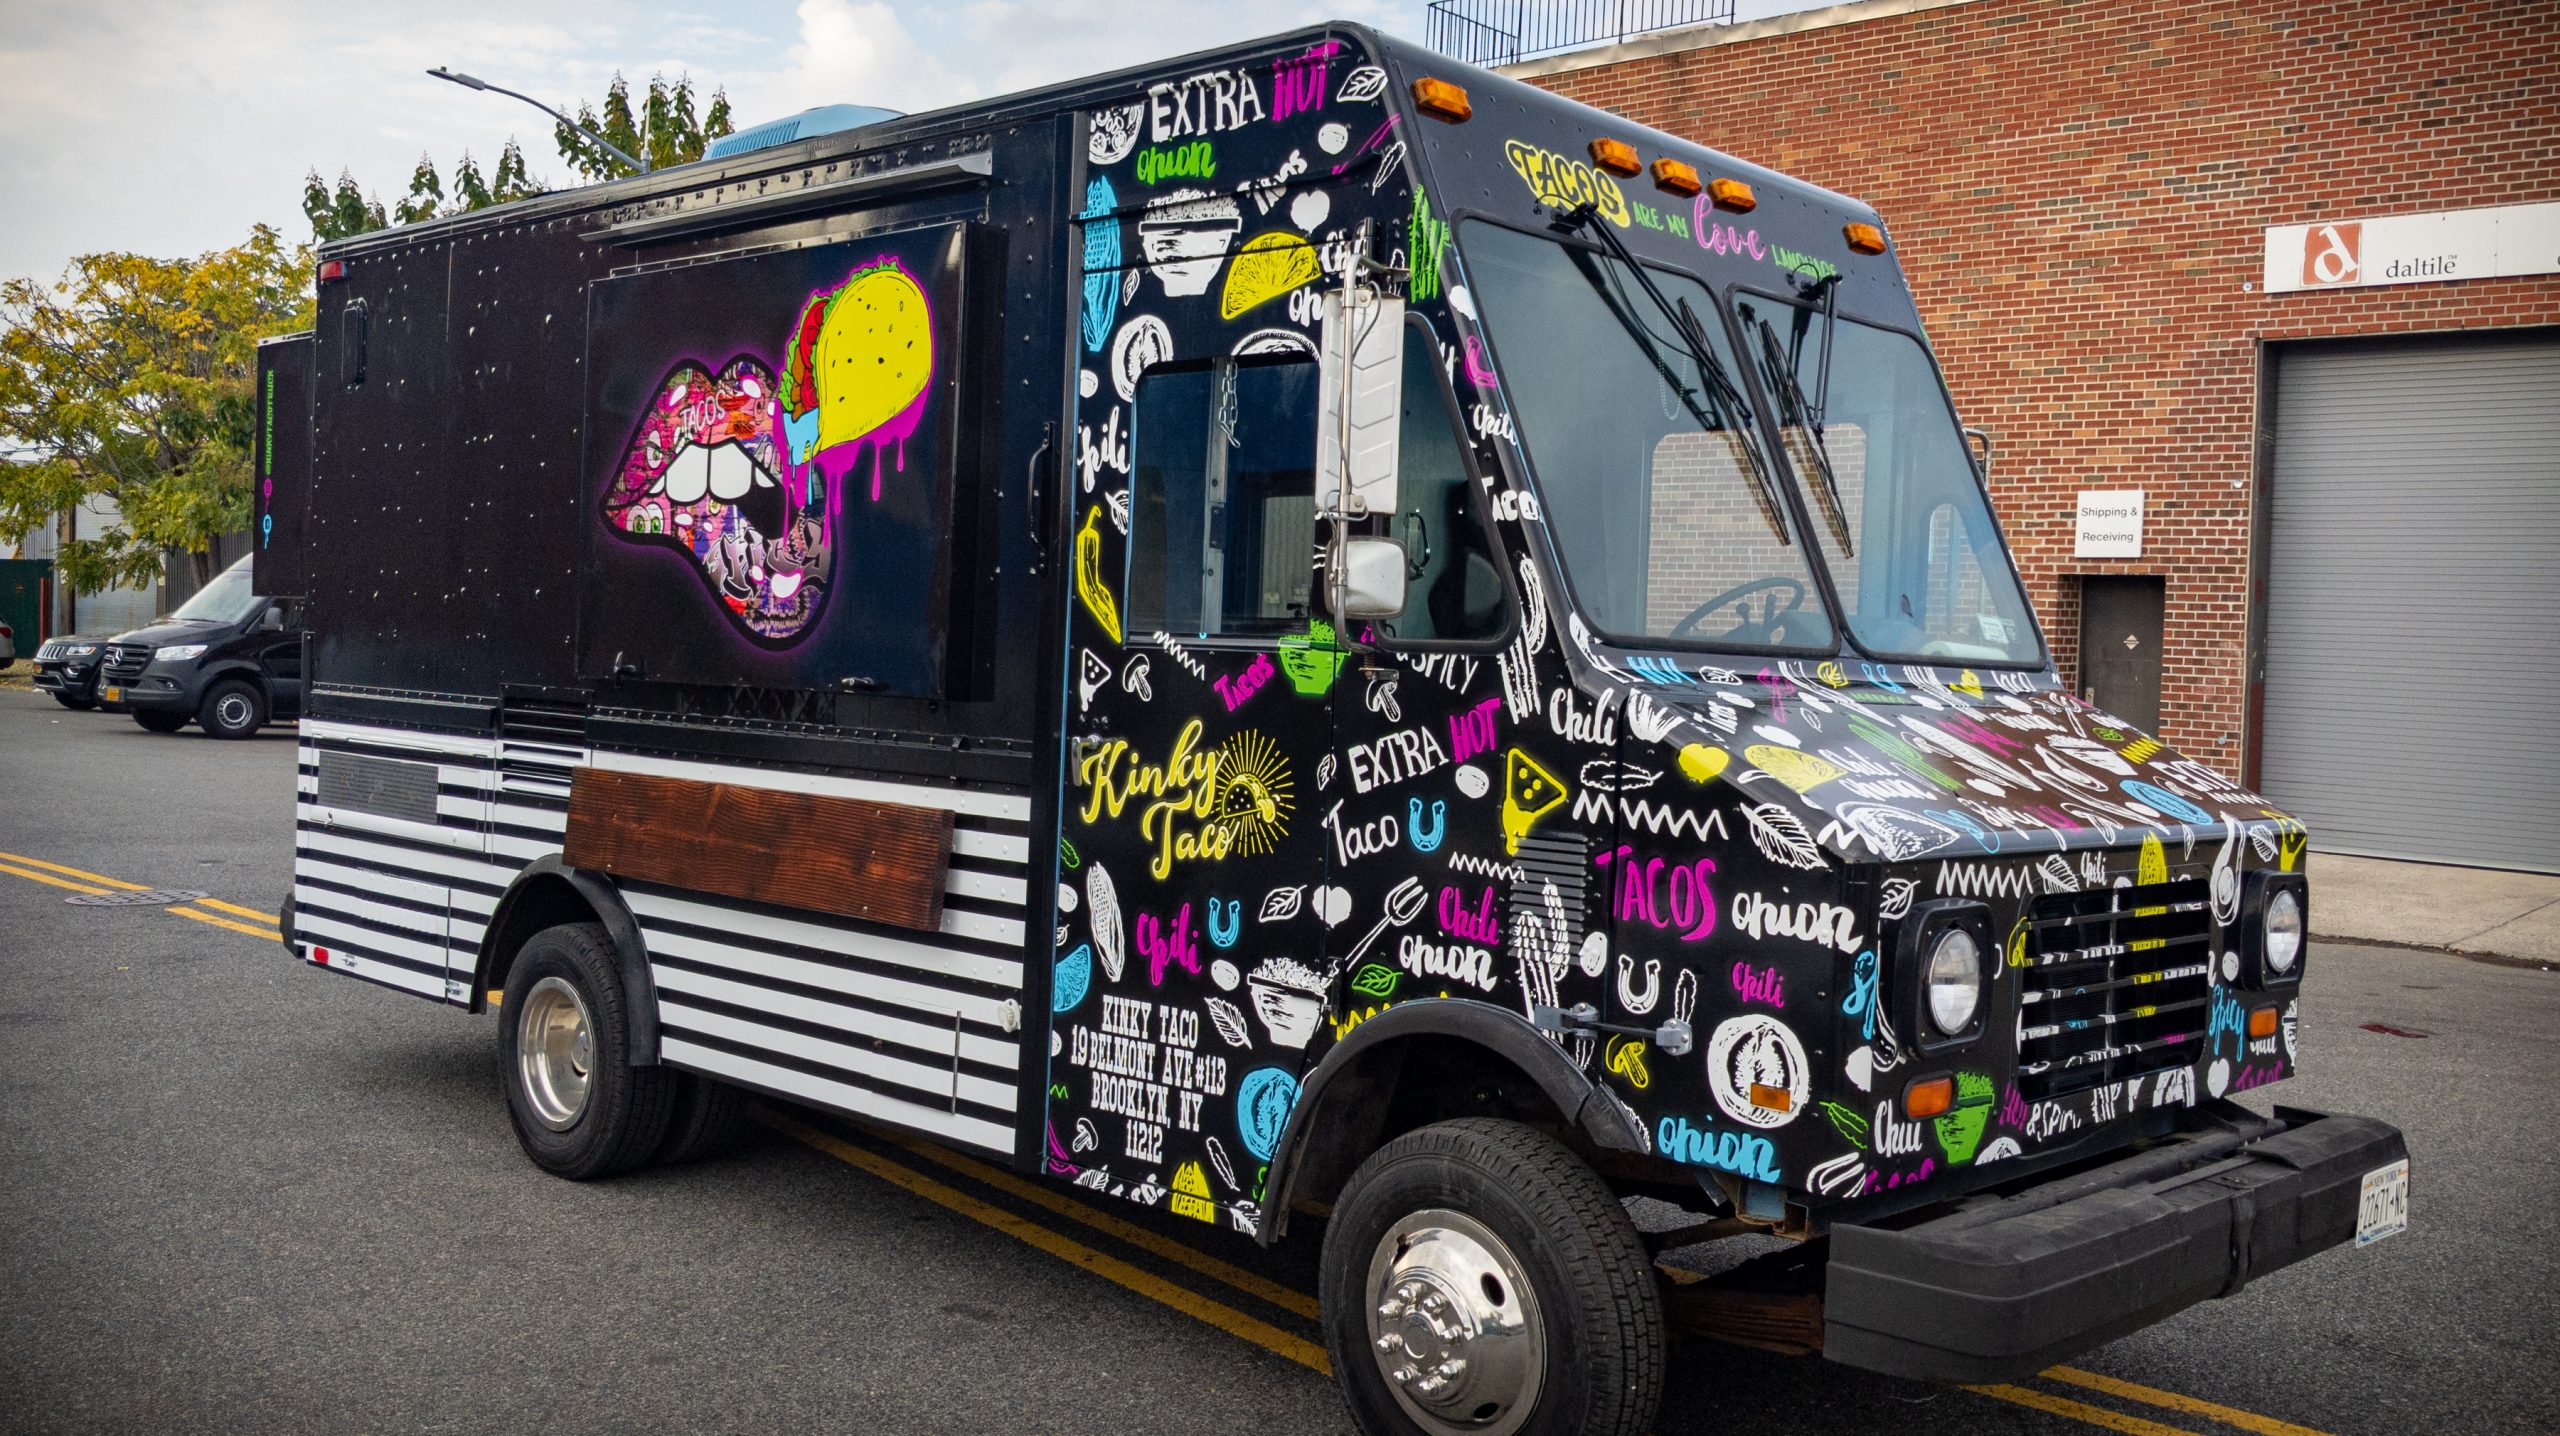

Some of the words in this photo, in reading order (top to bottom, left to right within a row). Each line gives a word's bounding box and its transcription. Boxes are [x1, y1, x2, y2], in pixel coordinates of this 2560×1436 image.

[1148, 68, 1266, 142] EXTRA
[1271, 41, 1340, 122] HOT
[1505, 139, 1630, 228] TACOS
[1633, 200, 1664, 231] ARE
[1667, 214, 1690, 239] MY
[2081, 507, 2127, 518] Shipping
[2130, 506, 2138, 517] &
[2082, 532, 2134, 543] Receiving
[1348, 726, 1450, 794] EXTRA
[1450, 697, 1501, 763] HOT
[1550, 687, 1618, 747] Chili
[1081, 719, 1229, 824] Kinky
[1142, 789, 1240, 880] Taco
[1322, 798, 1399, 867] Taco
[1438, 885, 1500, 946] Chili
[1595, 844, 1717, 941] TACOS
[1136, 902, 1203, 986] Chili
[1732, 961, 1785, 1009] Chili
[1102, 994, 1152, 1040] KINKY
[1159, 1004, 1199, 1050] TACO
[1070, 1024, 1088, 1066] 19
[1088, 1032, 1156, 1081] BELMONT
[1162, 1048, 1194, 1088] AVE
[1195, 1055, 1226, 1097] #113
[1091, 1073, 1171, 1129] BROOKLYN,
[1178, 1091, 1204, 1133] NY
[1125, 1120, 1163, 1165] 11212
